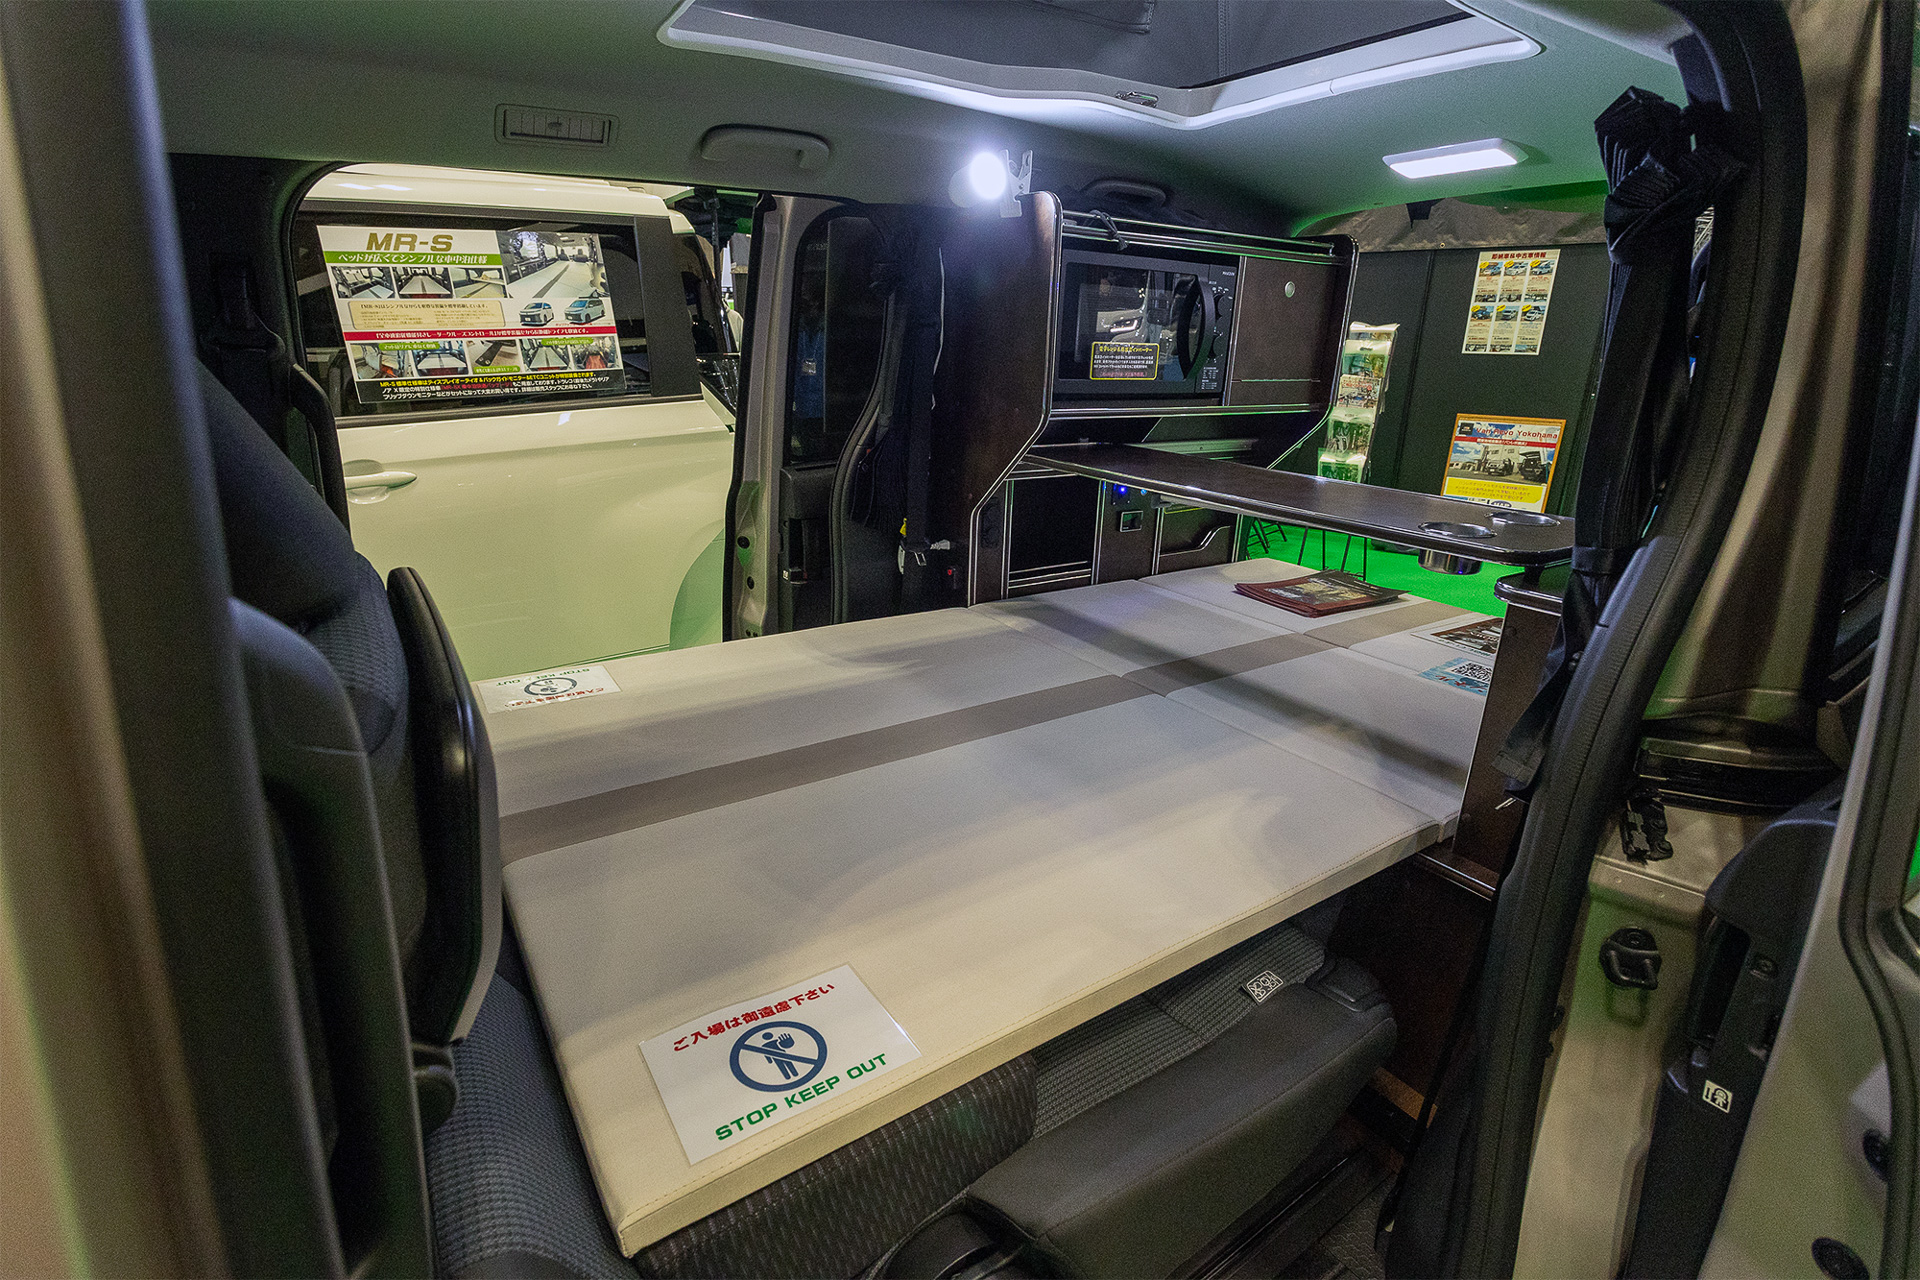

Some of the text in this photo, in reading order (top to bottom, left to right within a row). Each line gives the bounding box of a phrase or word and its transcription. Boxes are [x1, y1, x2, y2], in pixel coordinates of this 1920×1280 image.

[366, 232, 454, 252] MR-S
[1517, 430, 1558, 439] Yokohama
[495, 679, 521, 687] OUT
[673, 982, 835, 1052] ご入場は御遠慮下さい
[715, 1053, 886, 1141] STOP KEEP OUT
